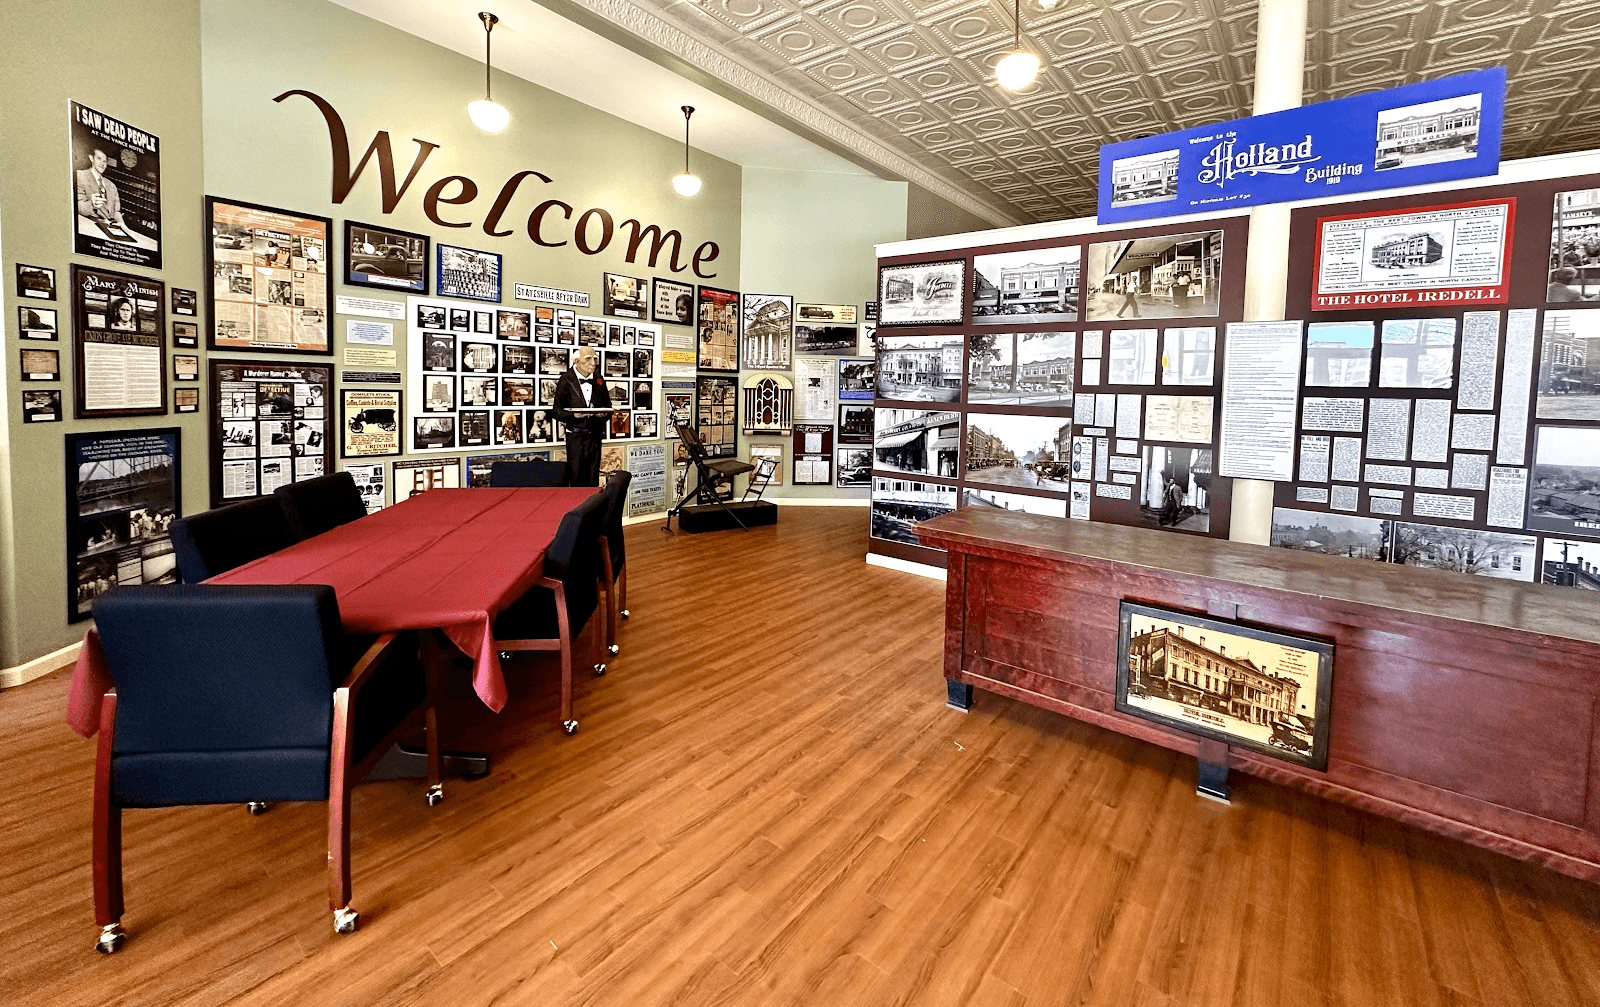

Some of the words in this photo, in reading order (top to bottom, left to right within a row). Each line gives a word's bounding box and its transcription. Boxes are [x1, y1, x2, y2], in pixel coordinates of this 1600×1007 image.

[76, 106, 80, 122] I
[82, 108, 102, 130] SAW
[104, 118, 126, 140] DEAD
[127, 127, 156, 153] PEOPLE
[111, 137, 128, 147] VANCE
[129, 145, 144, 154] HOTEL
[1189, 136, 1213, 145] Welcome
[1198, 134, 1315, 188] Holland
[1305, 162, 1363, 183] Building
[1326, 176, 1341, 185] 1919
[272, 89, 720, 279] Welcome
[556, 292, 573, 302] AFTER
[1317, 295, 1350, 306] THE
[1354, 292, 1412, 304] HOTEL
[1417, 289, 1500, 302] IREDELL
